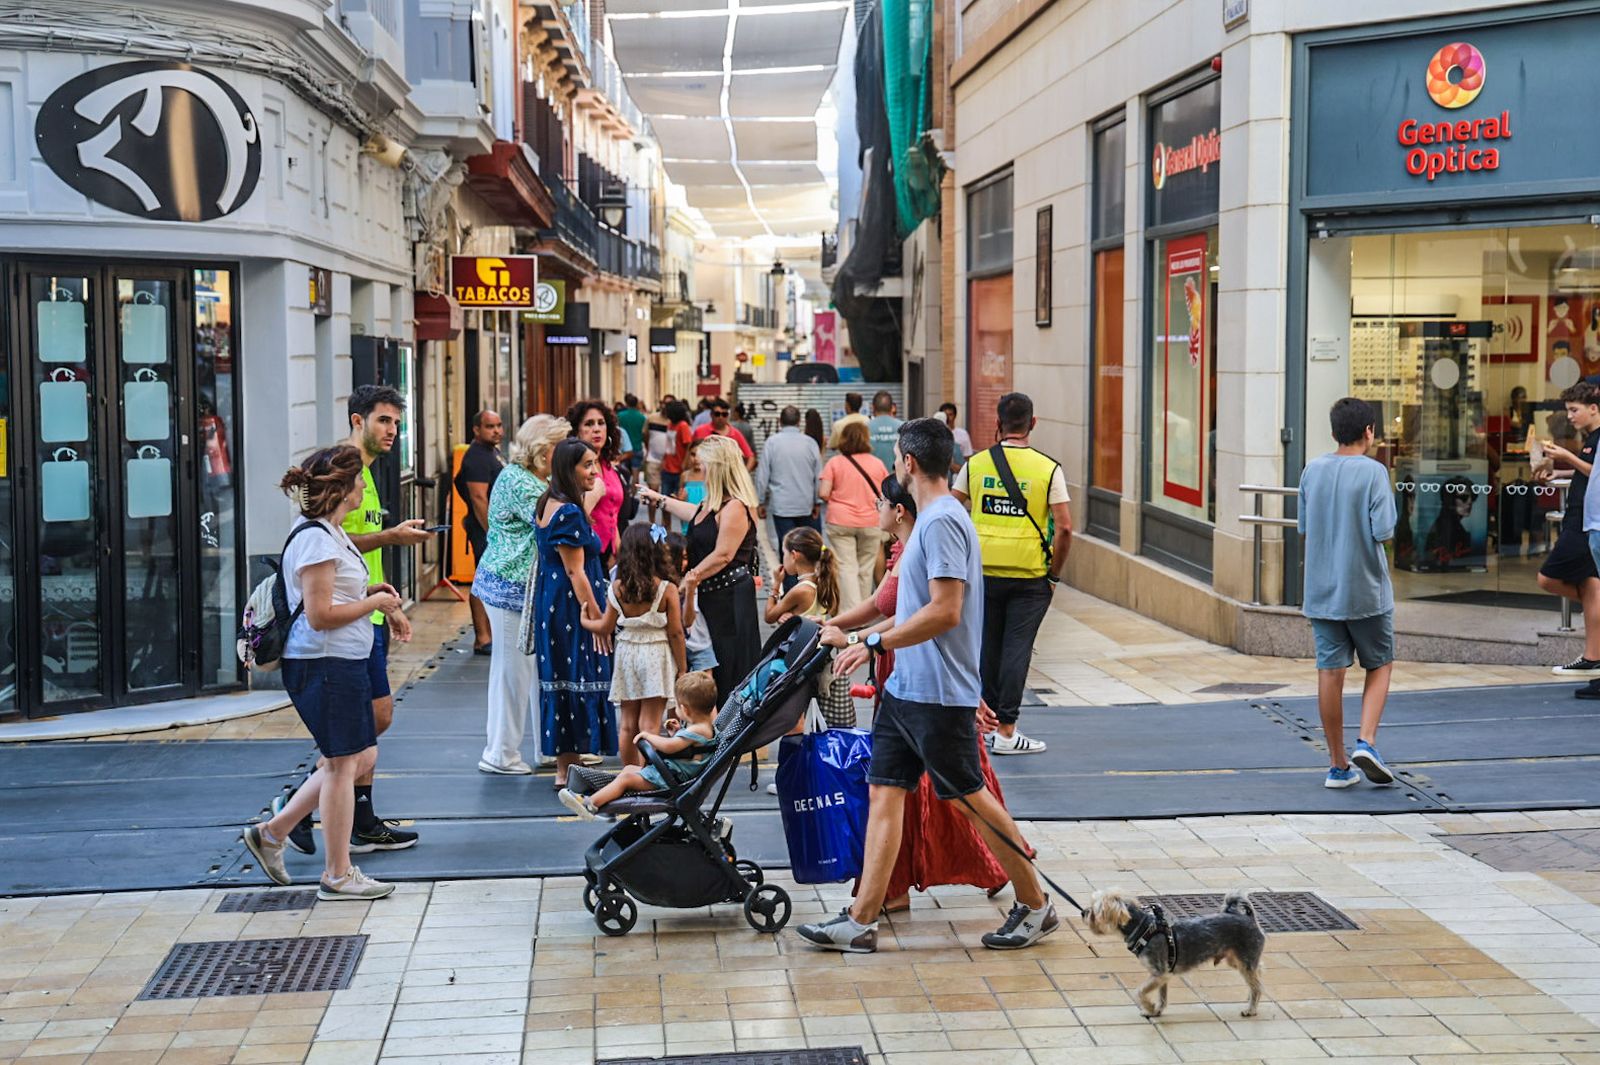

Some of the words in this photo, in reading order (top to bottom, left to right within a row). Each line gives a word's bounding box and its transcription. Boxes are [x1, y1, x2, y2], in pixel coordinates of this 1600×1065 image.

[1397, 109, 1512, 146] General
[1165, 136, 1197, 176] General
[1197, 128, 1220, 173] Optic
[1406, 143, 1500, 181] Optica
[456, 286, 531, 301] TABACOS
[993, 504, 1025, 515] ONCE
